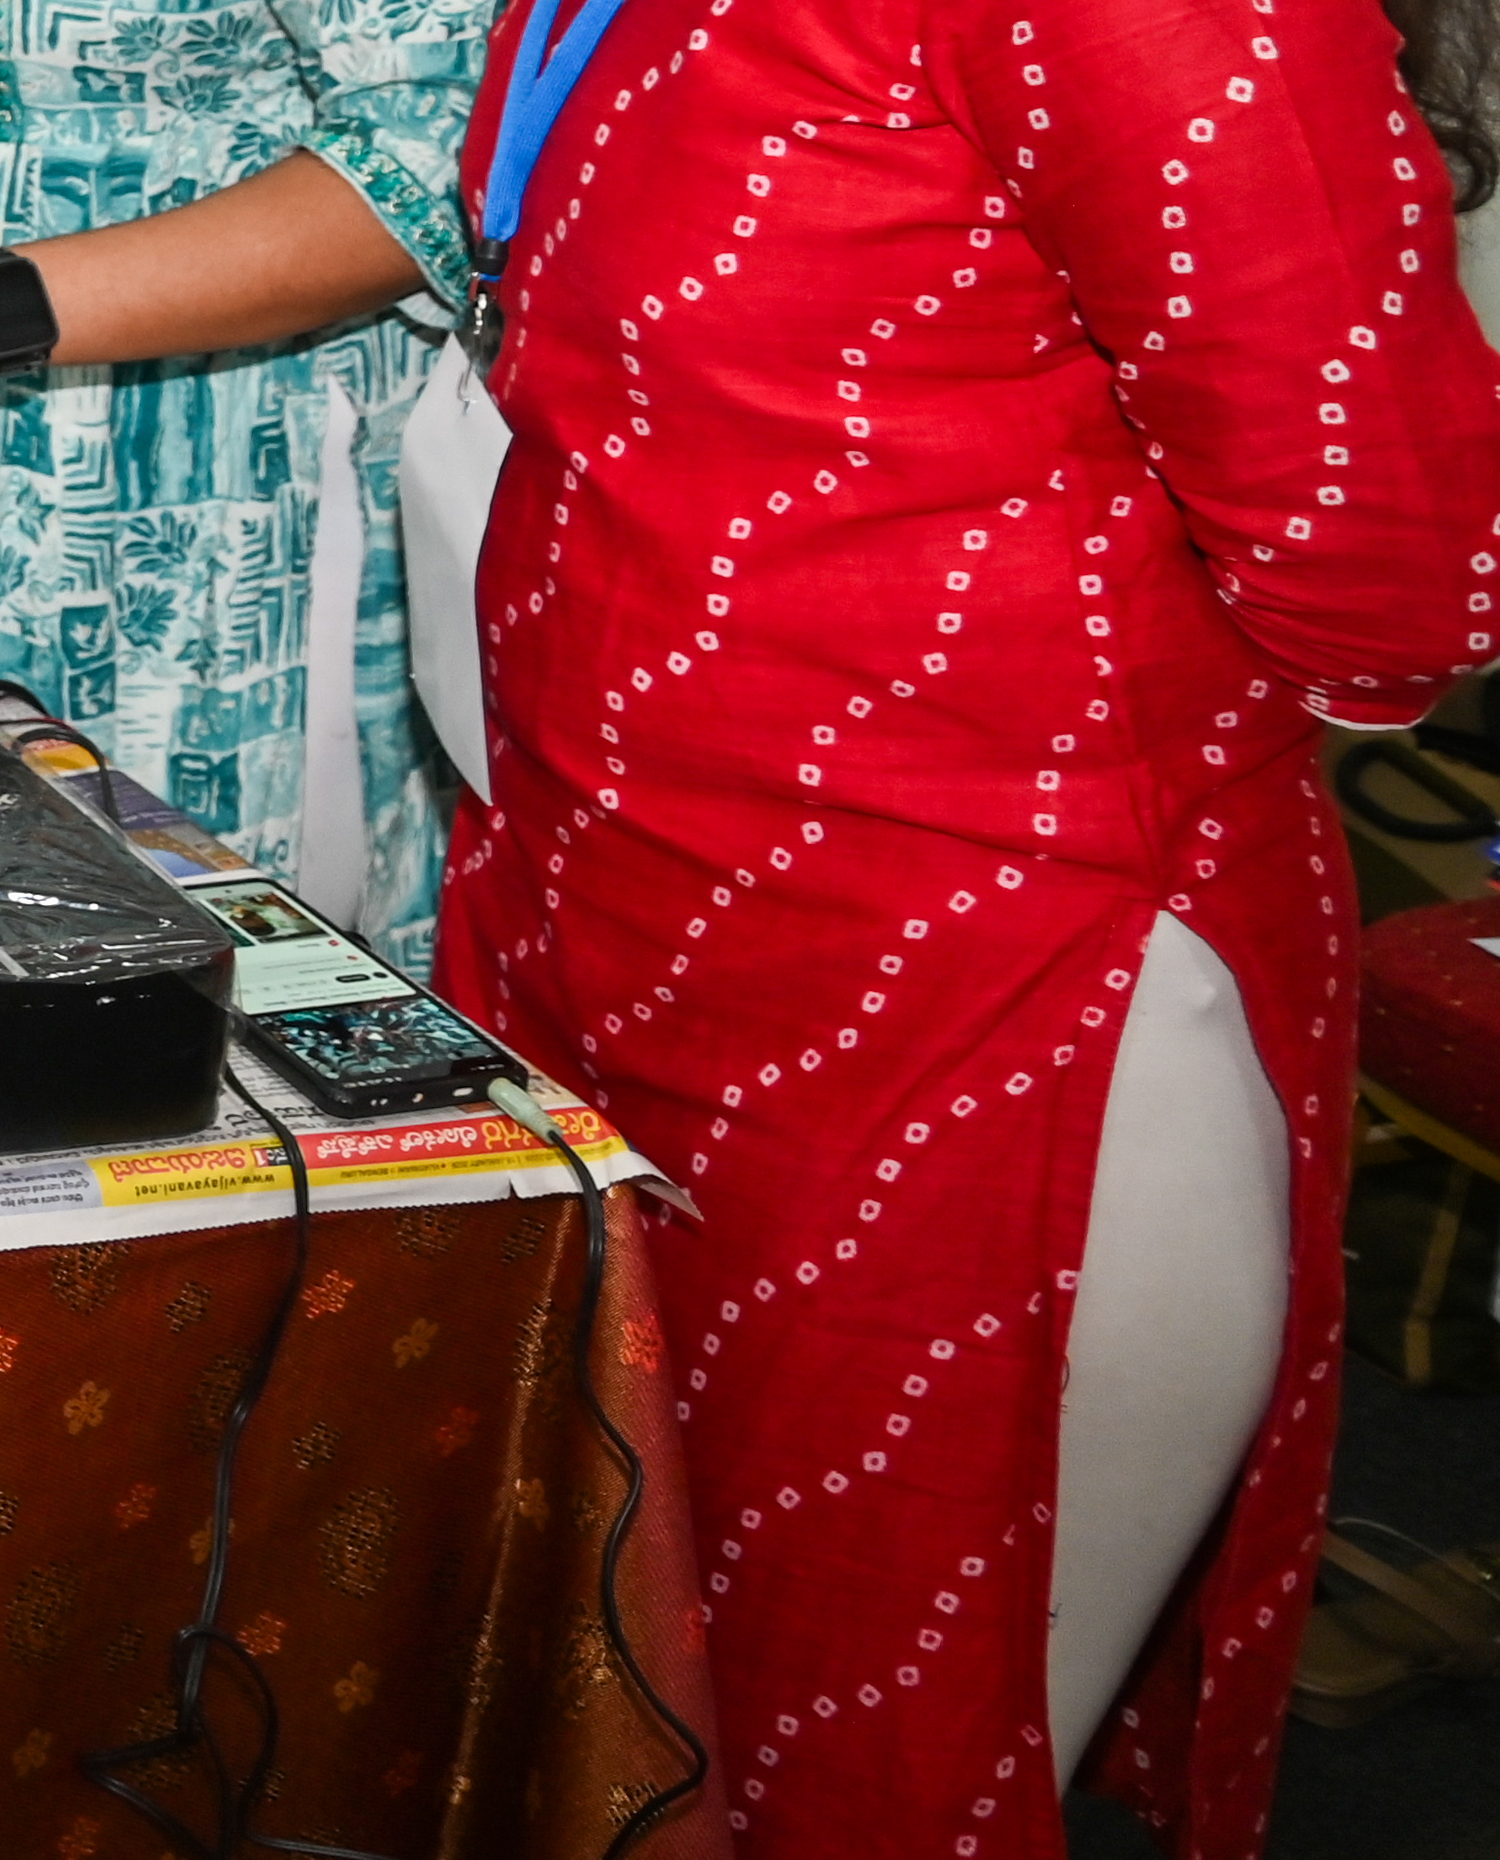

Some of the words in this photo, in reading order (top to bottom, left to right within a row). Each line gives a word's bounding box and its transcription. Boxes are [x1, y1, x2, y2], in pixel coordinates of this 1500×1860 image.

[400, 1125, 478, 1151] ಲೋಕಲ್
[109, 1147, 248, 1182] ವಿಜಯವಾಣಿ
[135, 1171, 275, 1199] www.vijayavani.net
